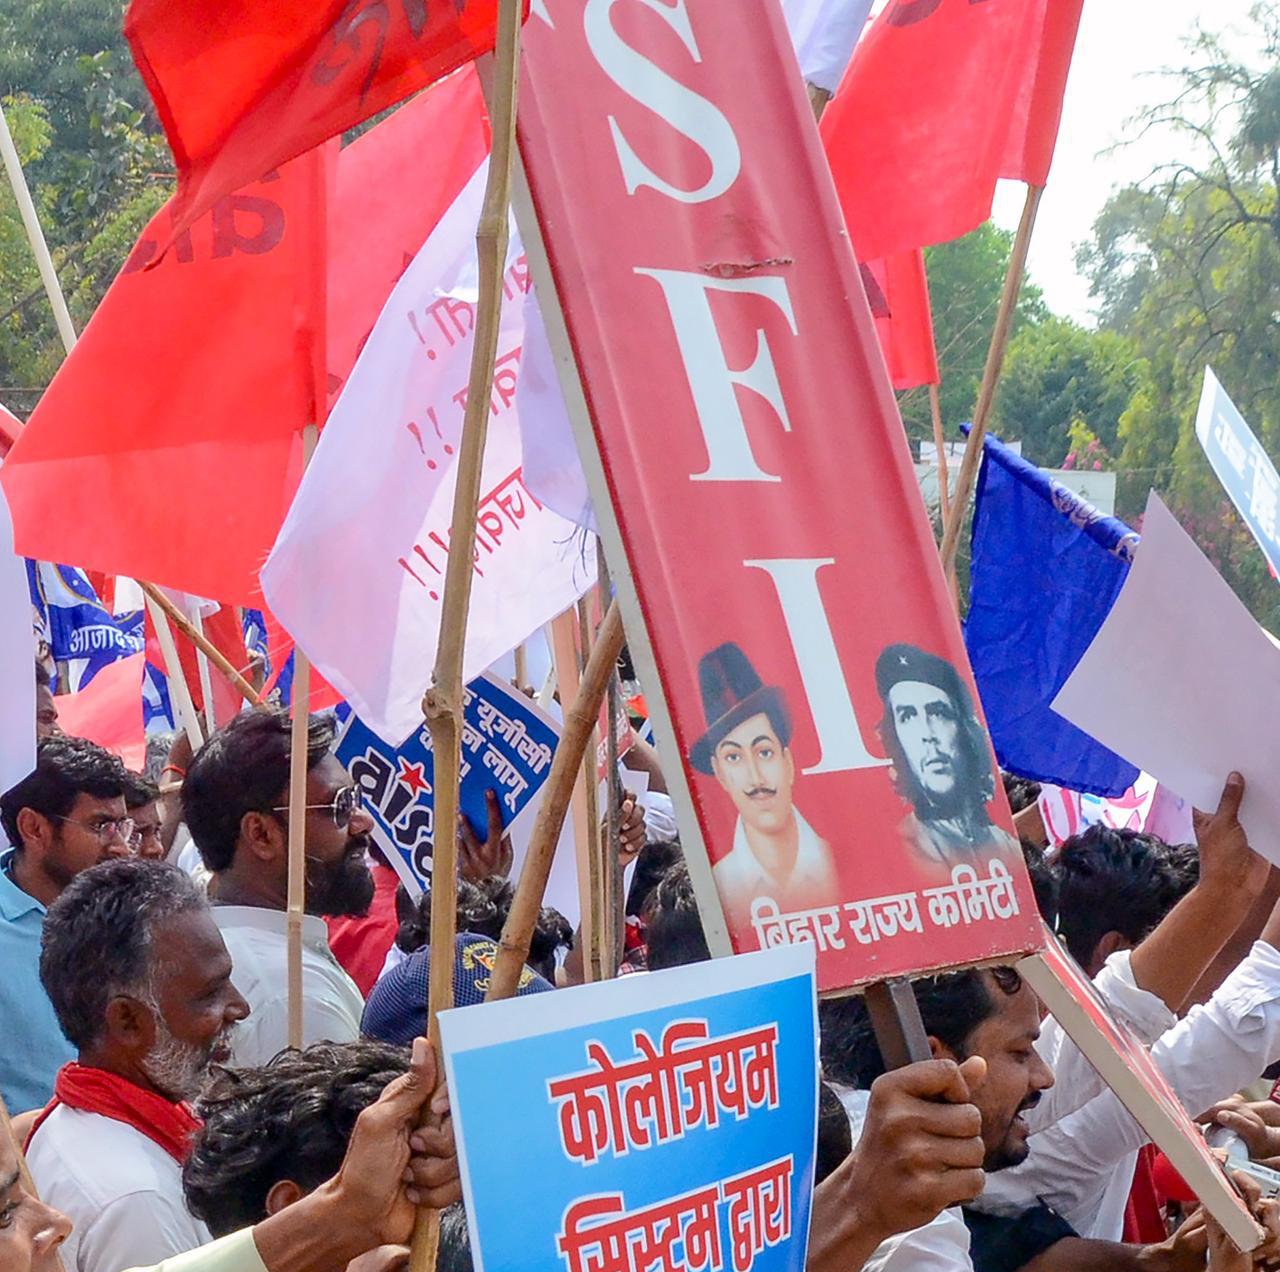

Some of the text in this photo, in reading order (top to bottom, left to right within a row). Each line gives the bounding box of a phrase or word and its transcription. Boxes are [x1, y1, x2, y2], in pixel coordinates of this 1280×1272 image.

[477, 697, 551, 774] यूजीसी
[483, 743, 528, 813] लागू
[751, 859, 1020, 952] बिहार राज्य कमिटी
[546, 1017, 779, 1166] कोलेजियम
